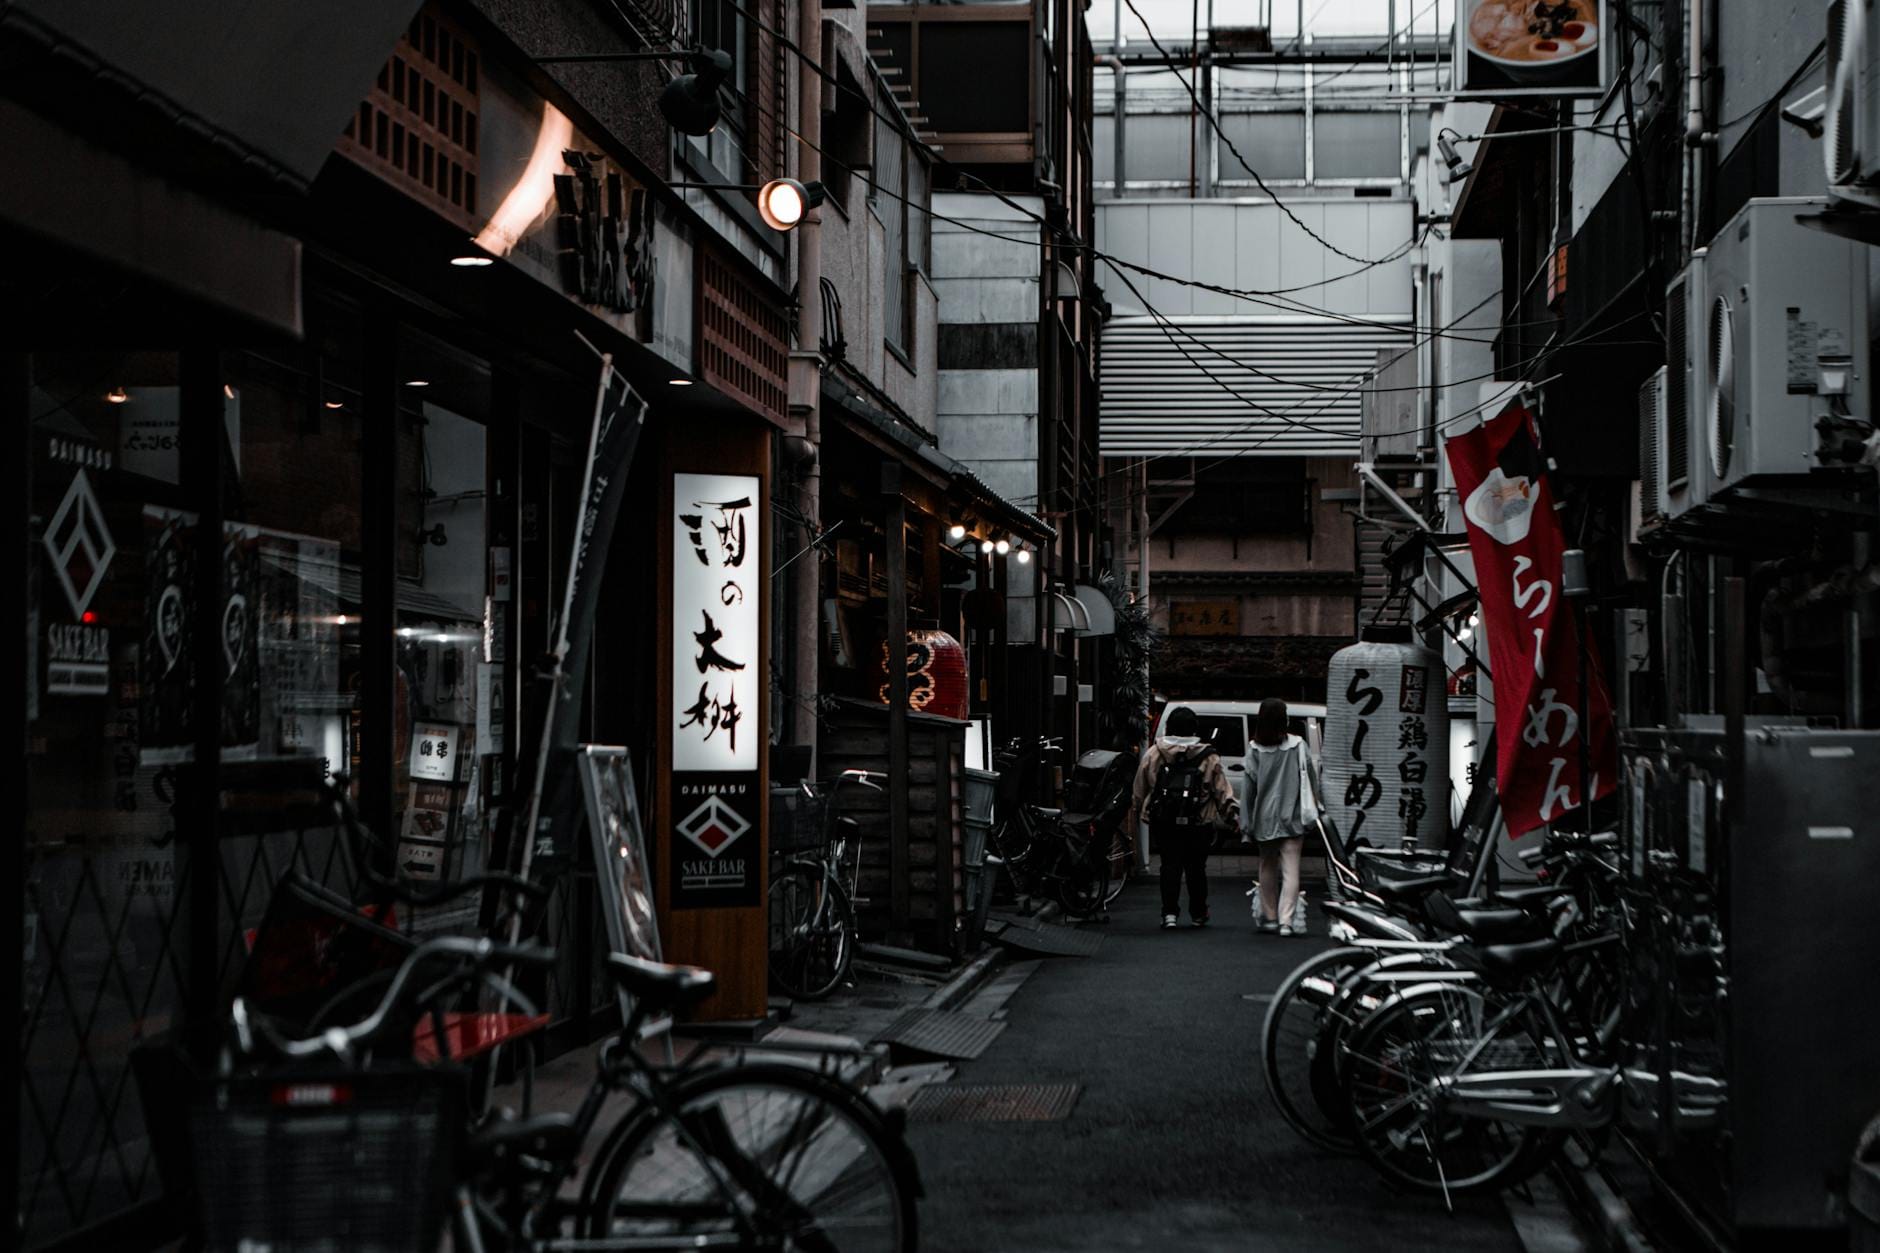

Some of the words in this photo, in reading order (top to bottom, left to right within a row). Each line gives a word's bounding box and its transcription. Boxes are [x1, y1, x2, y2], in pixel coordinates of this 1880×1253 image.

[1512, 554, 1581, 822] らーめん
[682, 784, 746, 794] DAIMASU
[1345, 668, 1384, 853] らーめん
[682, 860, 717, 874] SAKE
[719, 859, 745, 874] BAR
